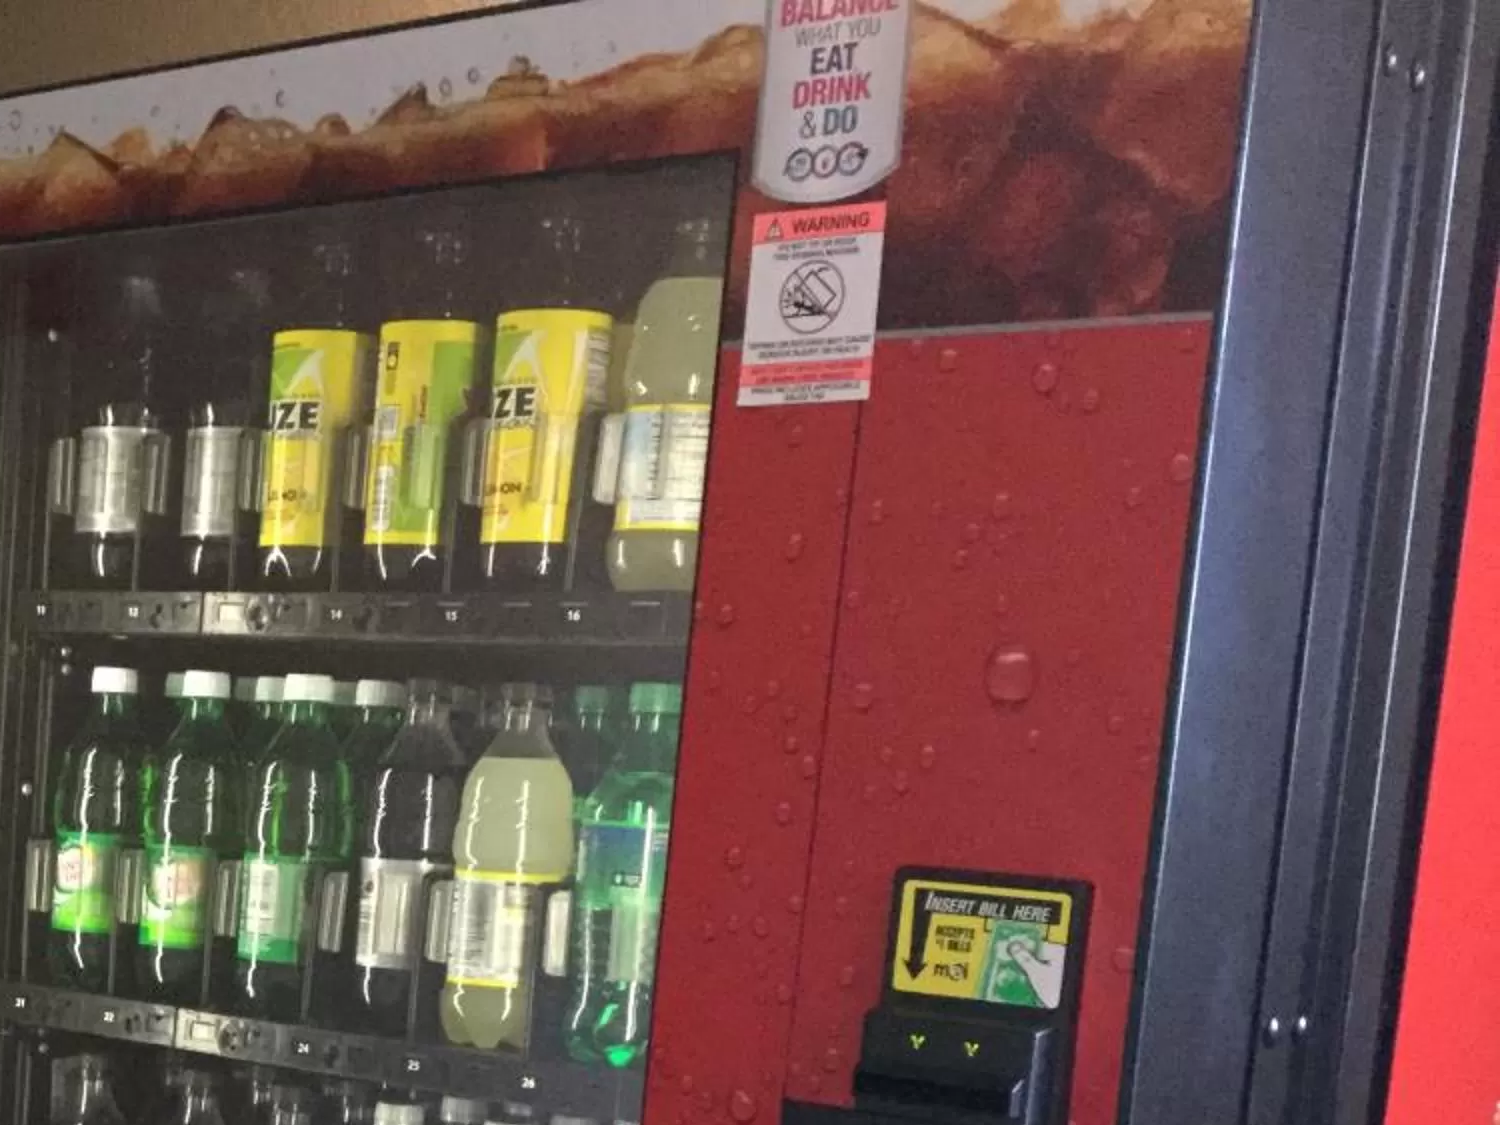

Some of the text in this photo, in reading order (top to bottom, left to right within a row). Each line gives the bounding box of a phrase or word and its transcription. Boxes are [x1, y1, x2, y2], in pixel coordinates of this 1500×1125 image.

[795, 16, 882, 46] WHAT YOU
[810, 42, 859, 74] EAT
[792, 71, 872, 110] DRINK
[798, 104, 859, 139] & DO
[791, 211, 871, 234] WARNING
[269, 401, 322, 431] ZE
[1012, 904, 1053, 923] HERE
